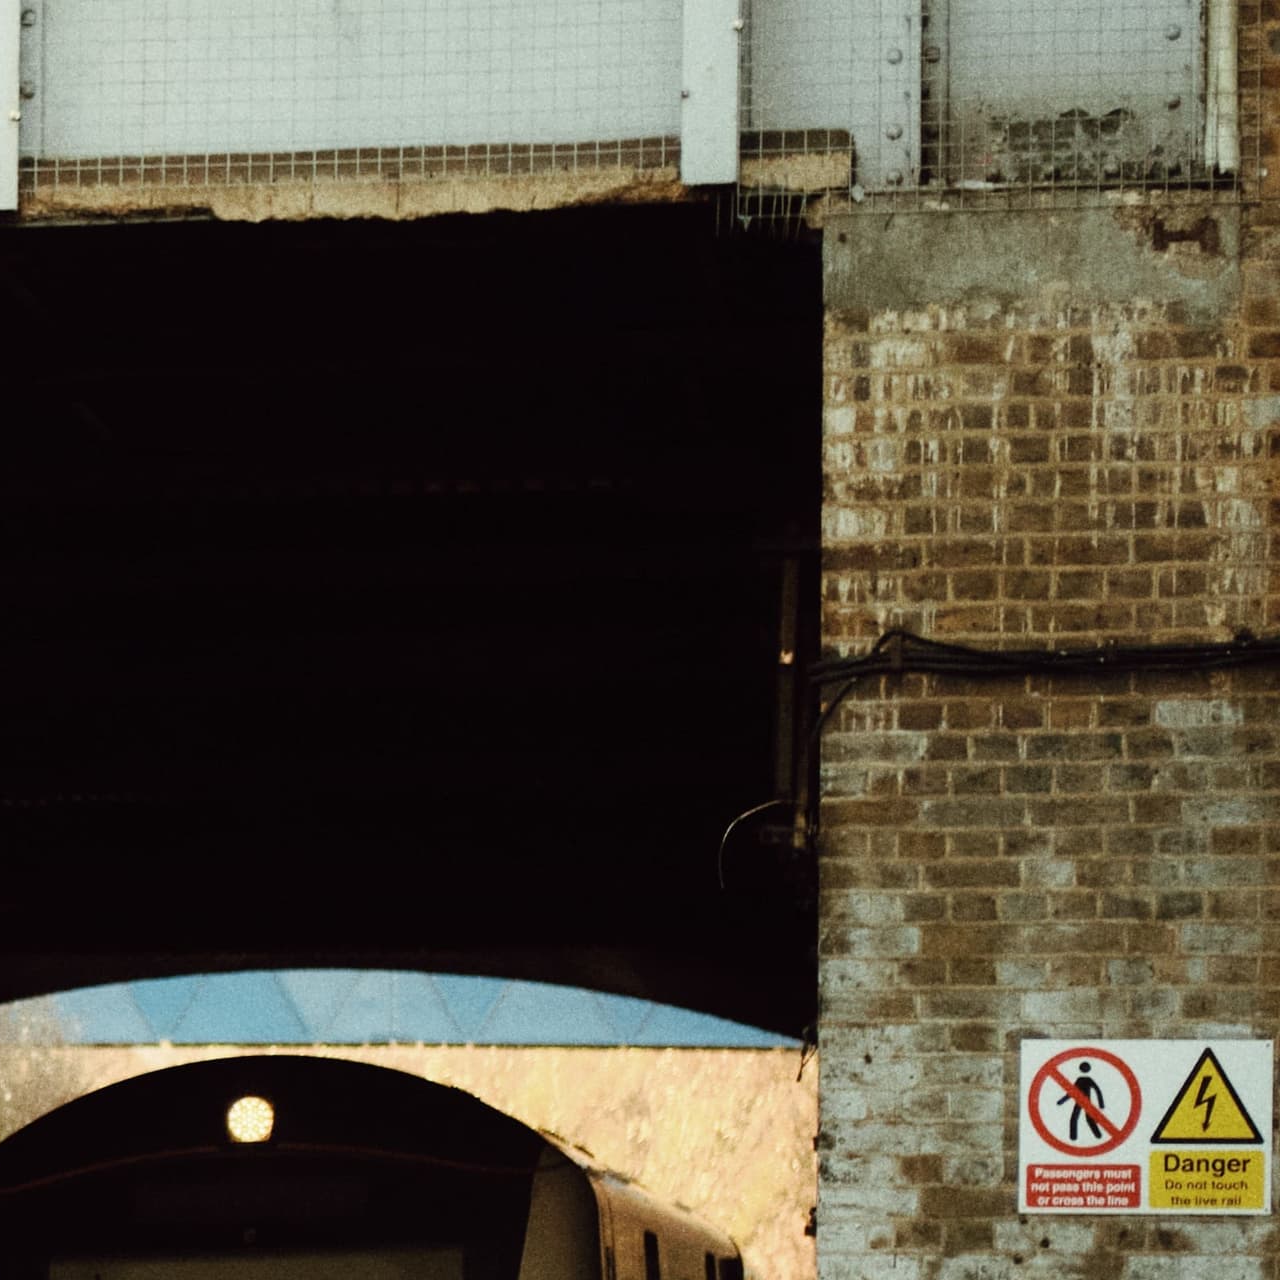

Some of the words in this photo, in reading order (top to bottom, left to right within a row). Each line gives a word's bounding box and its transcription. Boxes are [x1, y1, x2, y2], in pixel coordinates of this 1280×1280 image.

[1163, 1153, 1251, 1177] Danger
[1034, 1167, 1101, 1181] Passengers
[1103, 1168, 1132, 1179] must
[1030, 1182, 1050, 1193] not
[1051, 1183, 1080, 1195] pass
[1082, 1182, 1104, 1193] this
[1106, 1182, 1136, 1195] point
[1164, 1180, 1183, 1191] Do
[1186, 1180, 1207, 1191] not
[1211, 1180, 1249, 1191] touch
[1037, 1196, 1050, 1206] or
[1051, 1196, 1085, 1206] cross
[1086, 1195, 1106, 1206] the
[1107, 1195, 1130, 1206] line
[1170, 1195, 1191, 1206] the
[1194, 1195, 1217, 1206] live
[1221, 1195, 1242, 1206] rail
